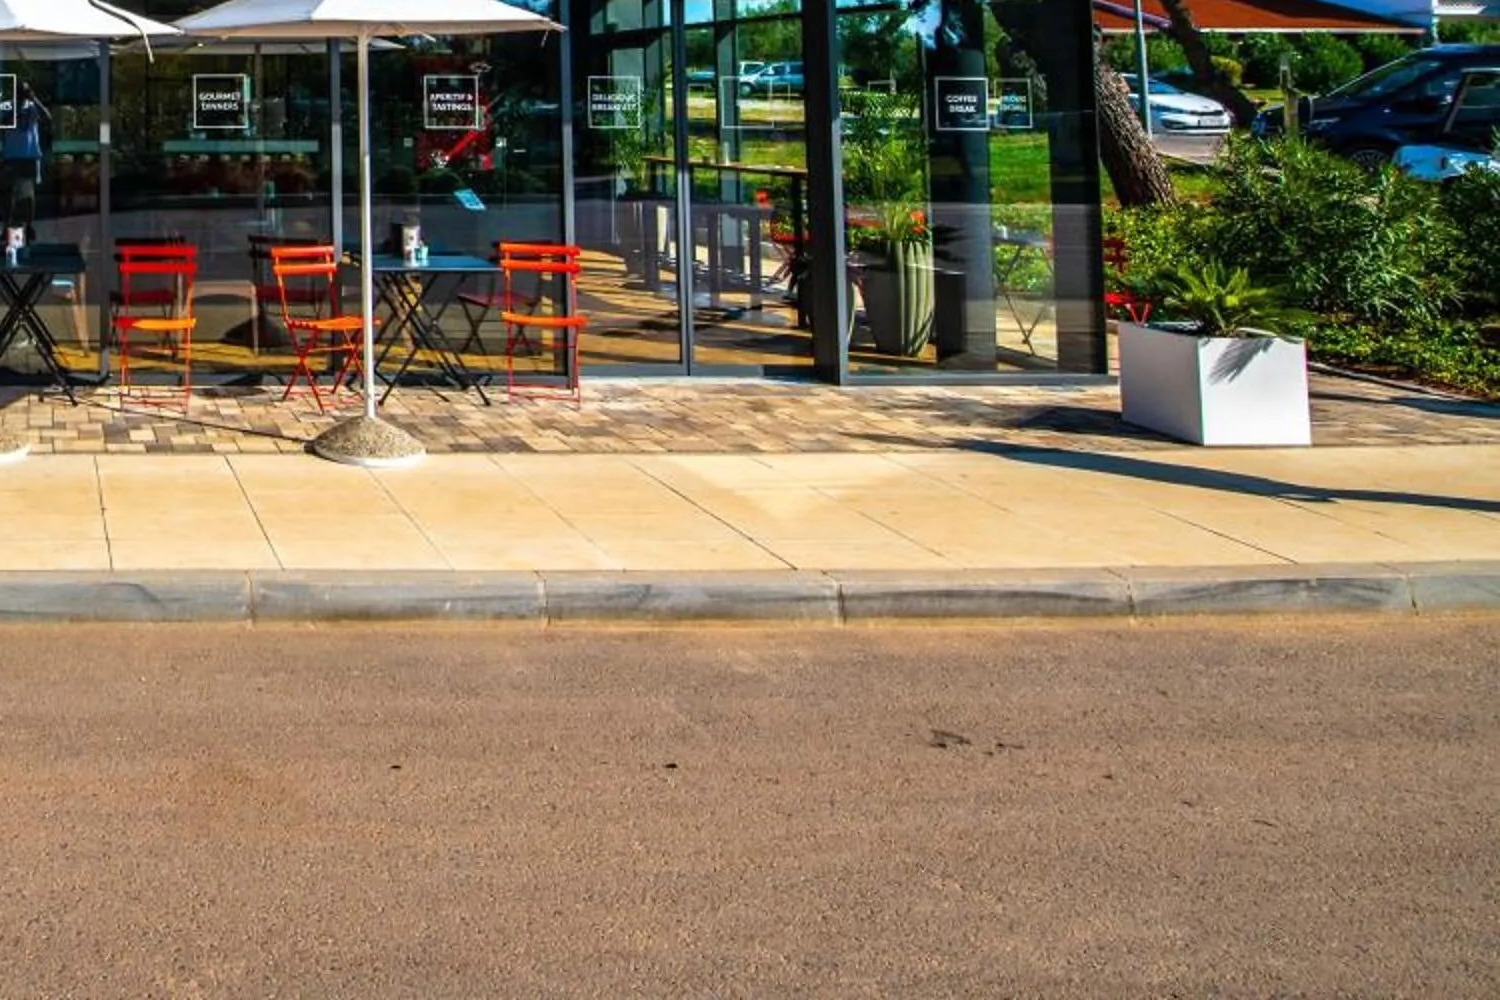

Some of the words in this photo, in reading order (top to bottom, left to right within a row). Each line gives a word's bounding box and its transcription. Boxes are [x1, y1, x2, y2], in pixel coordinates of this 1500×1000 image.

[198, 91, 241, 101] GOURMET
[945, 95, 978, 104] COFFEE
[201, 102, 239, 111] DINNERS
[432, 103, 473, 111] TASTINGS
[949, 104, 977, 113] BREAK
